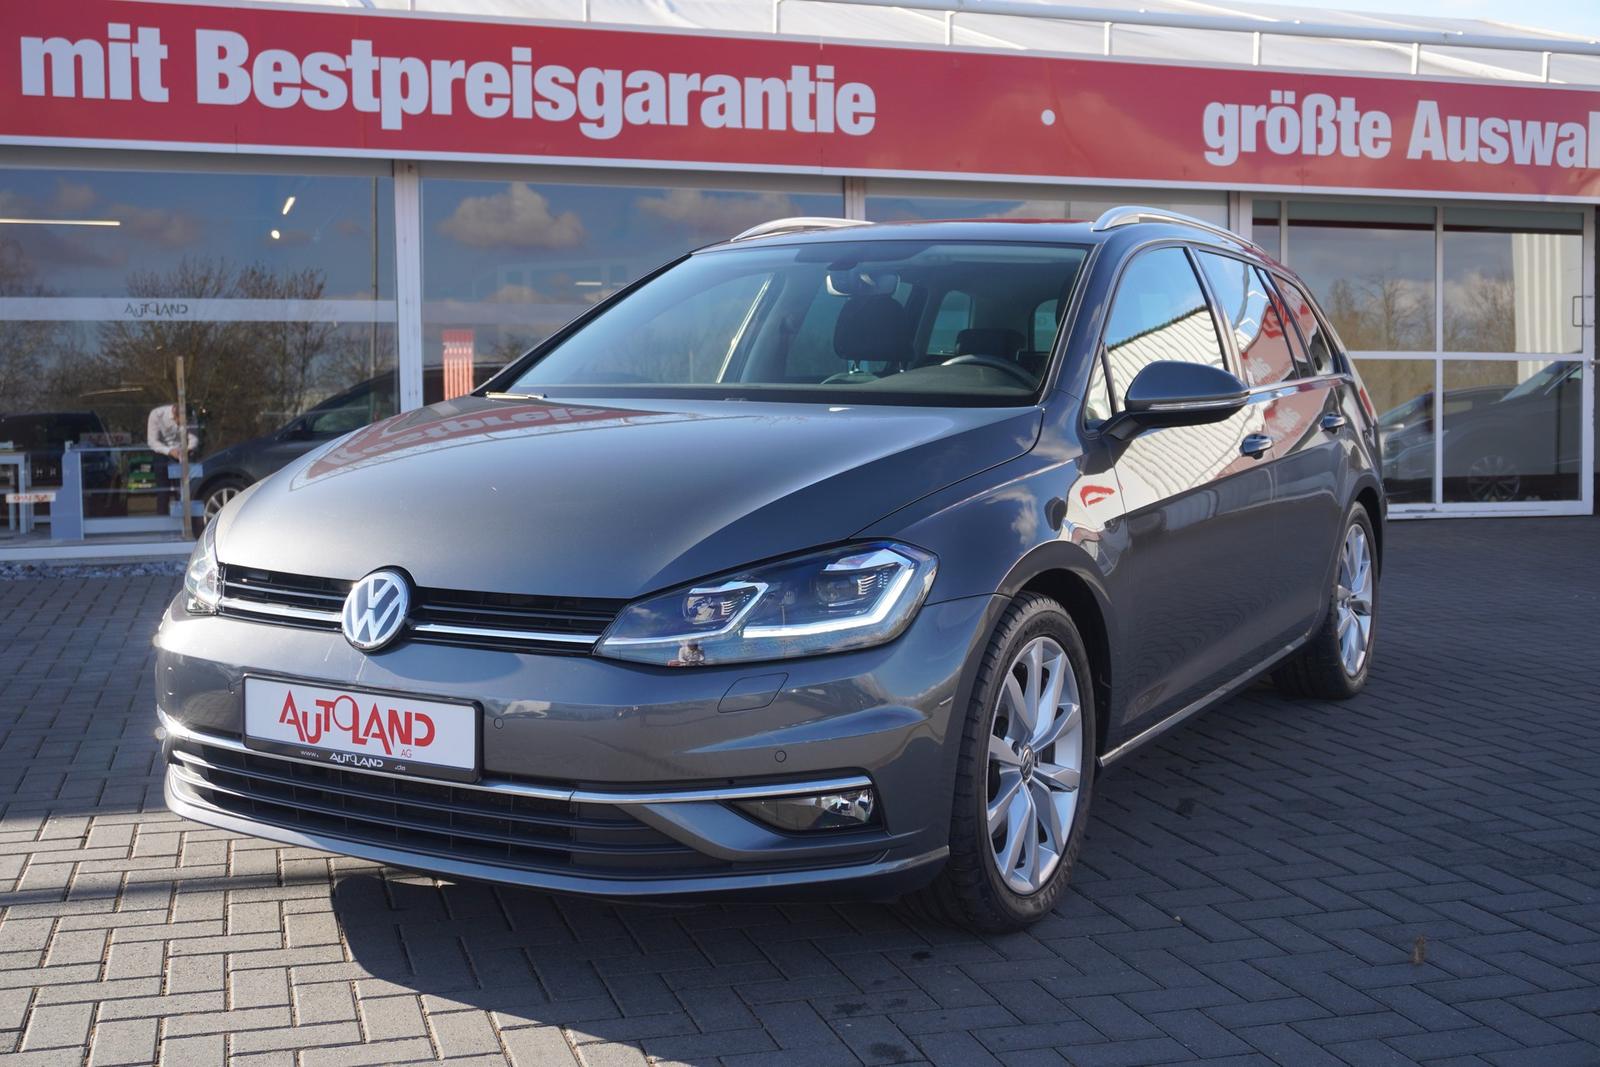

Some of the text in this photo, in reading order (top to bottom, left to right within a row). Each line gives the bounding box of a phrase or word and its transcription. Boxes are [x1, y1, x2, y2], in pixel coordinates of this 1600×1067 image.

[20, 22, 877, 141] mit Bestpreisgarantie
[1202, 90, 1393, 167] größte
[401, 748, 412, 758] AG
